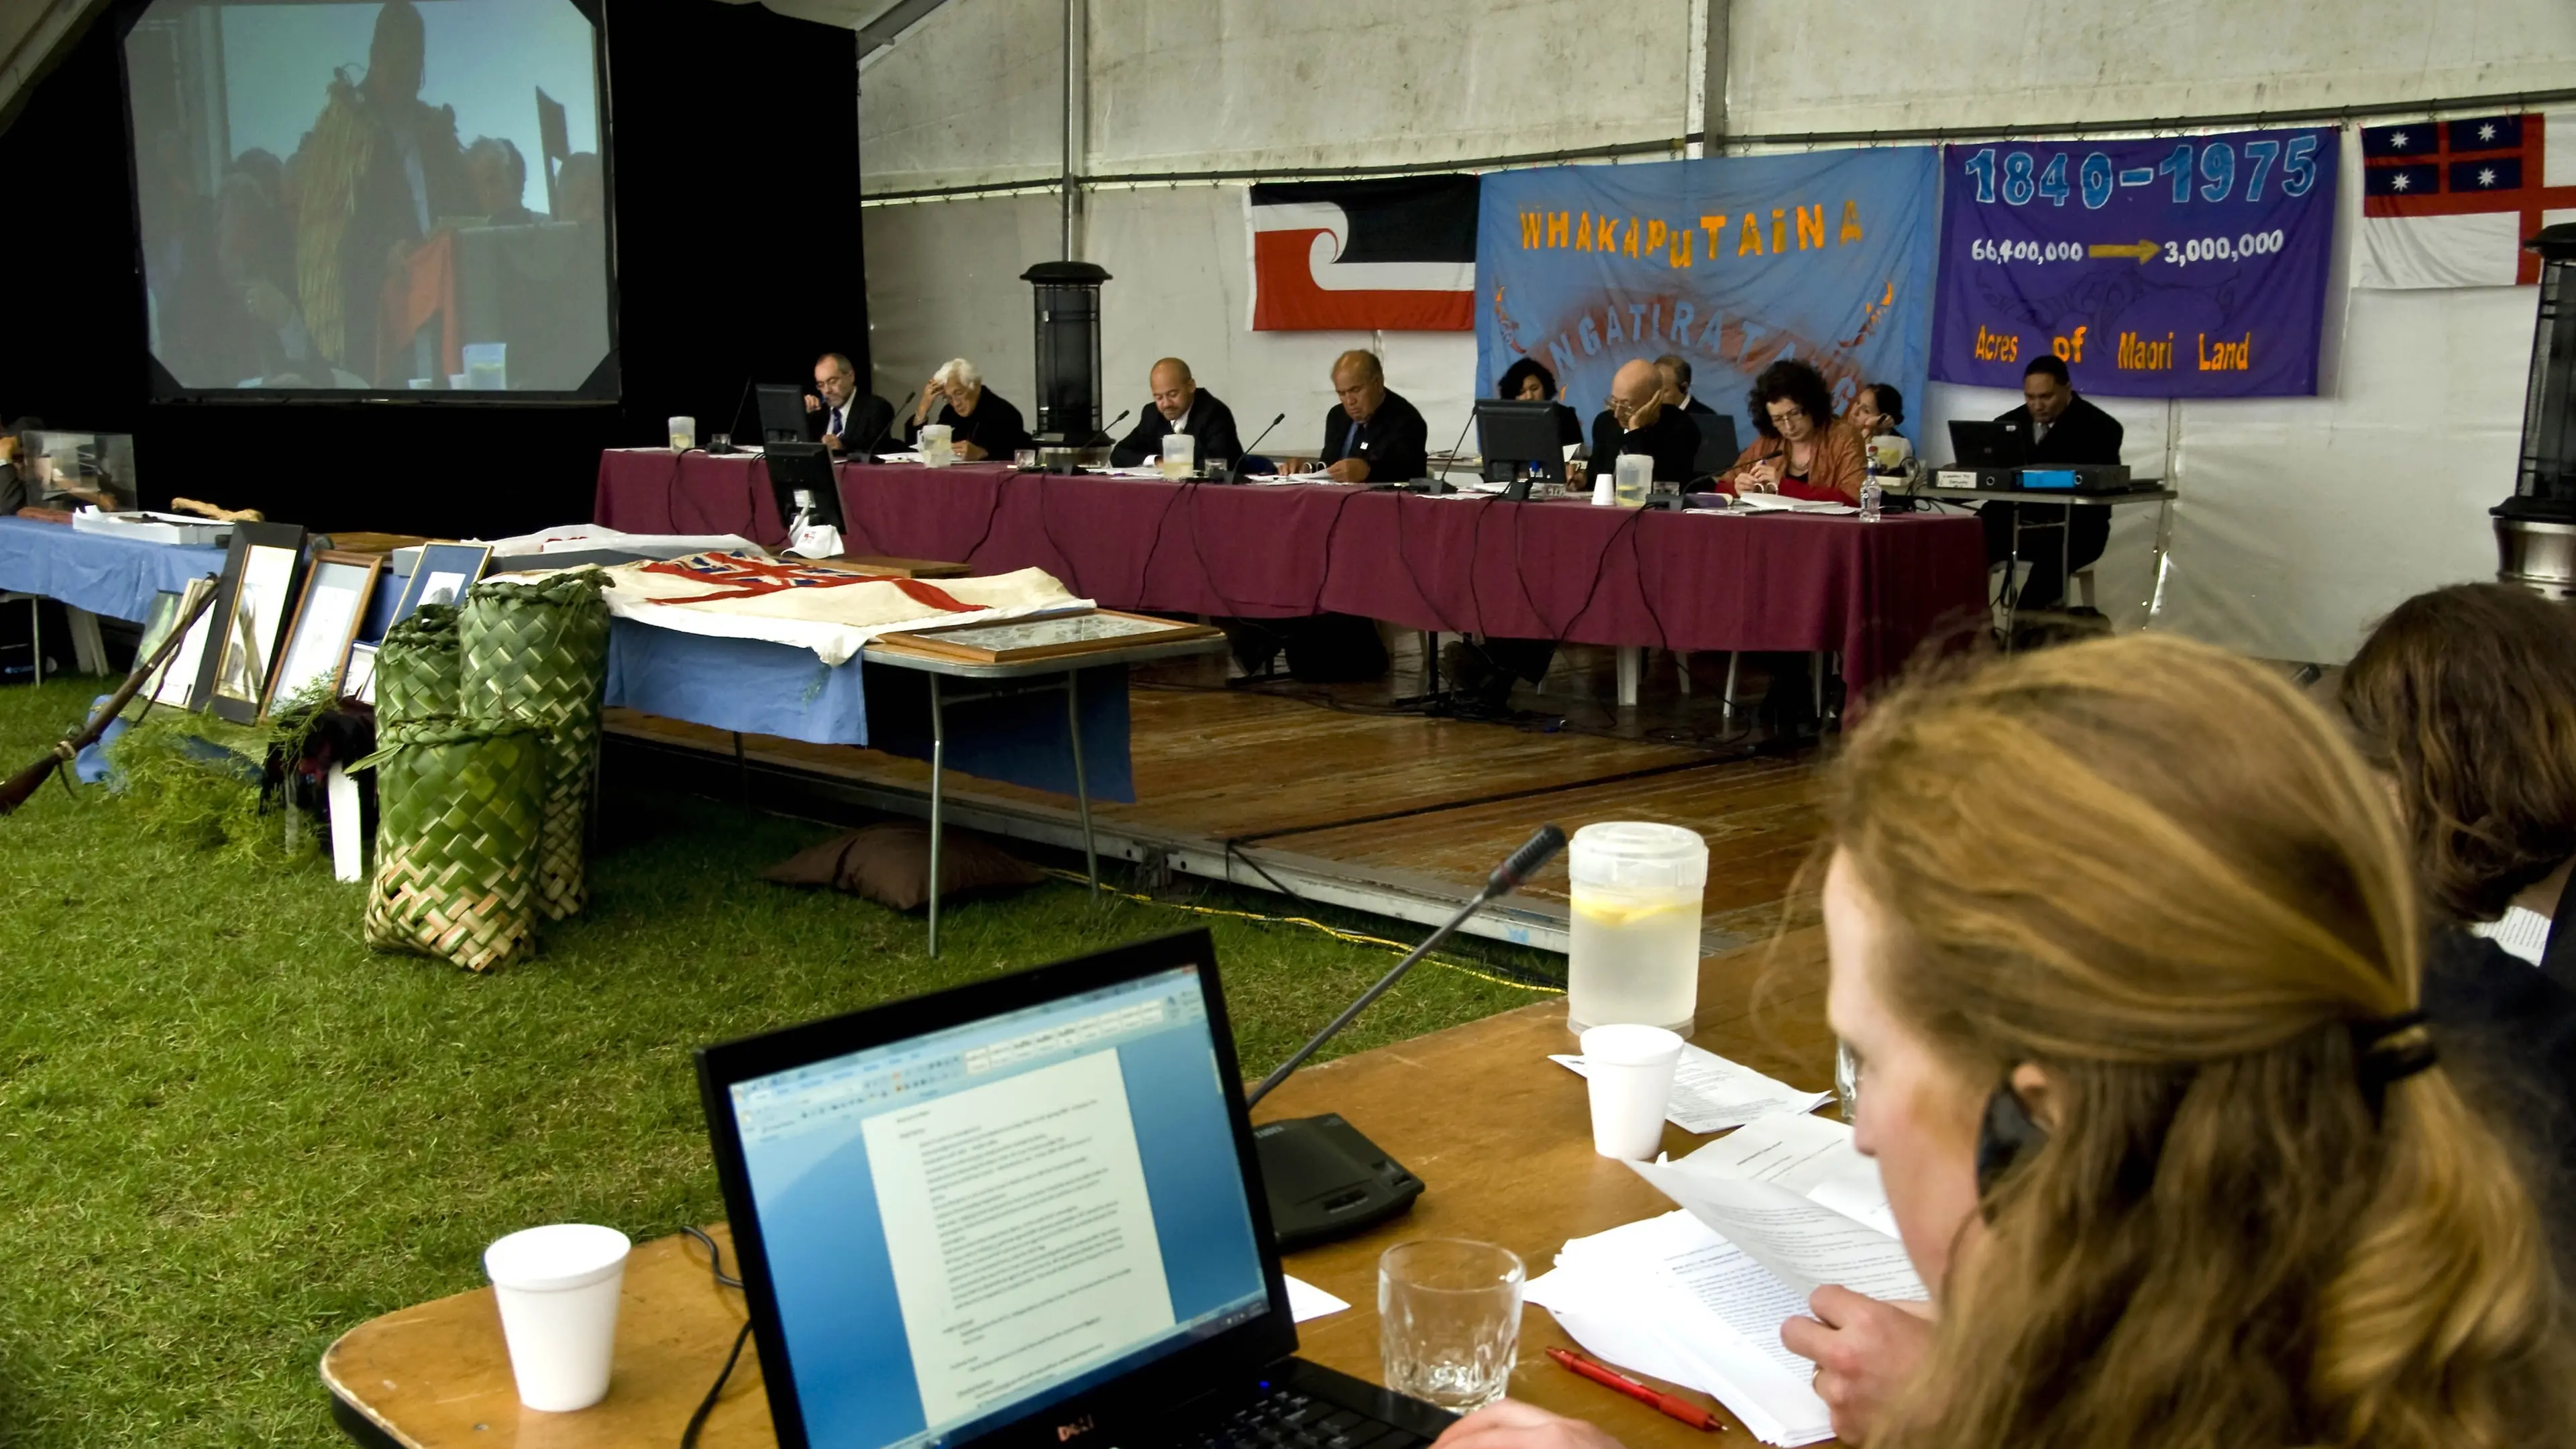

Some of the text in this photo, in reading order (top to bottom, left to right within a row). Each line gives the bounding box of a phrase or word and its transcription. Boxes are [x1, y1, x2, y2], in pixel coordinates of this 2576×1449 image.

[1965, 135, 2318, 210] 1840-1975
[1971, 229, 2284, 268] 66,400,000 3,000,000
[1975, 325, 2251, 371] Acres of Maori Land
